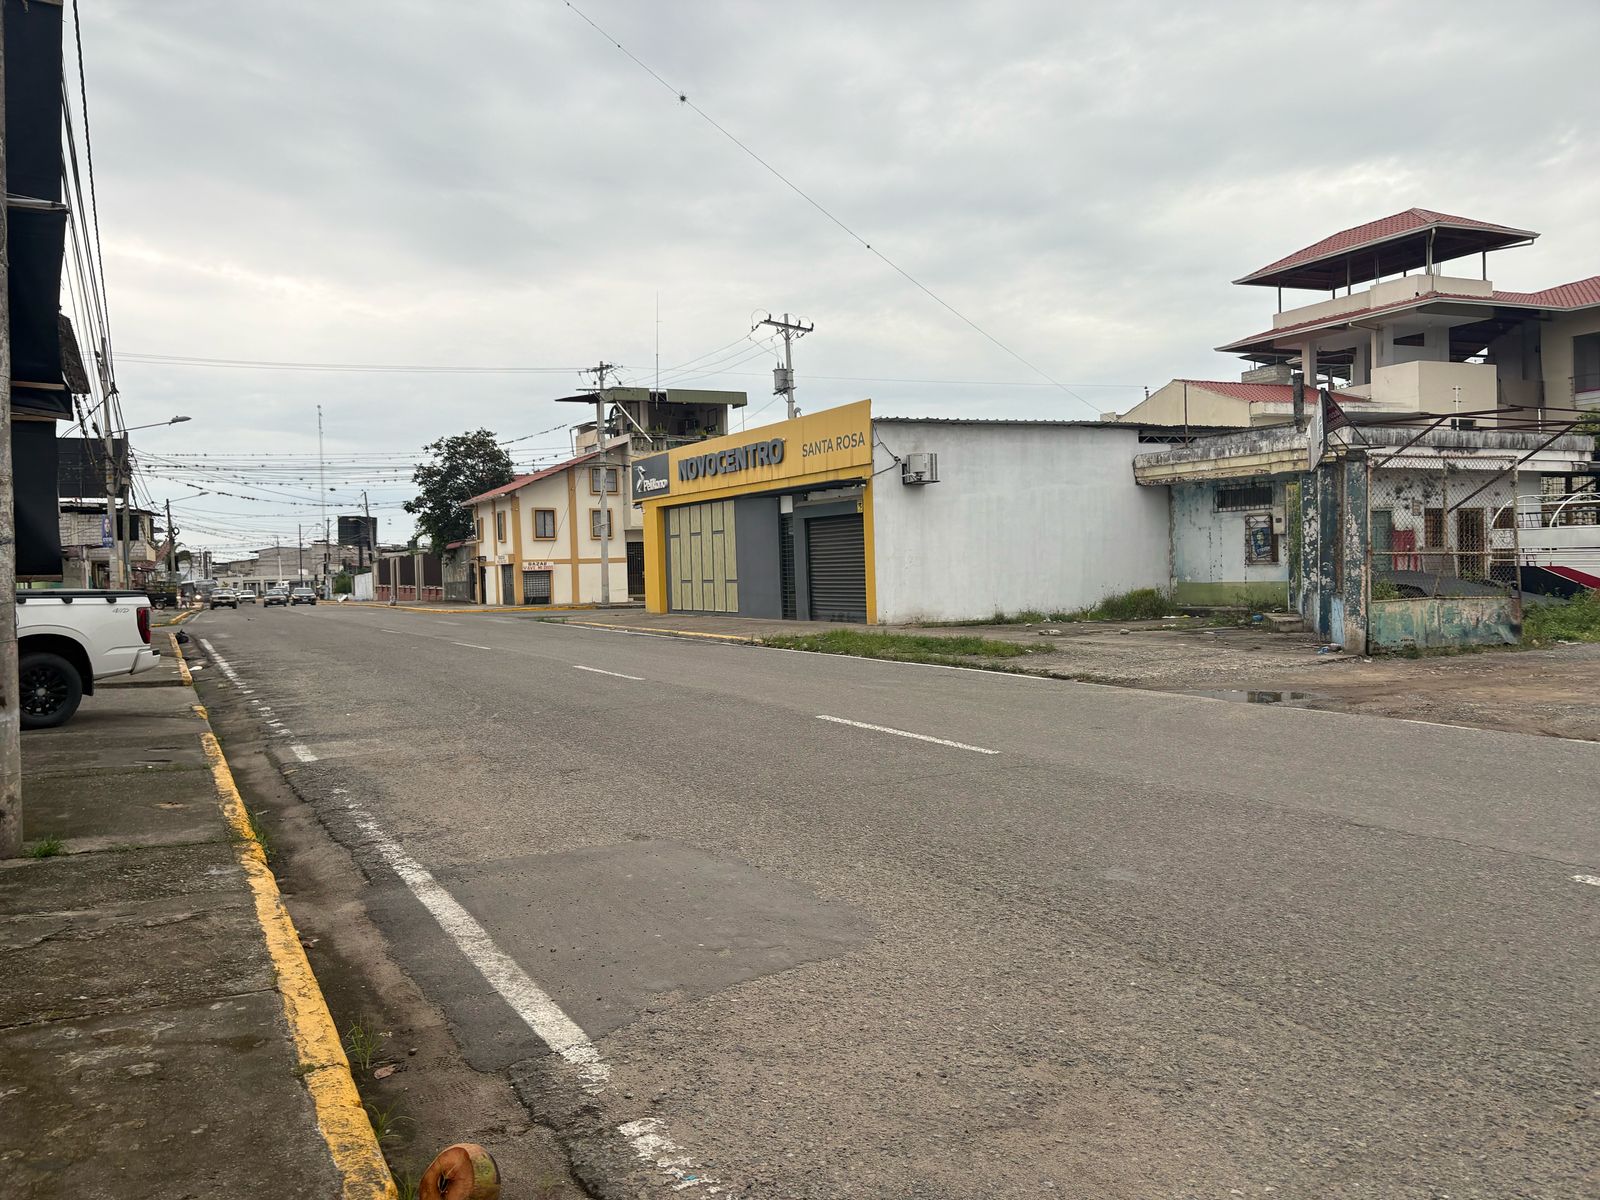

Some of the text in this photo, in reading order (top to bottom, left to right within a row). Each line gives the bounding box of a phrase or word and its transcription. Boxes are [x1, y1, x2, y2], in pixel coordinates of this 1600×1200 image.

[678, 438, 785, 482] NOVOCENTRO
[802, 431, 866, 458] SANTA ROSA
